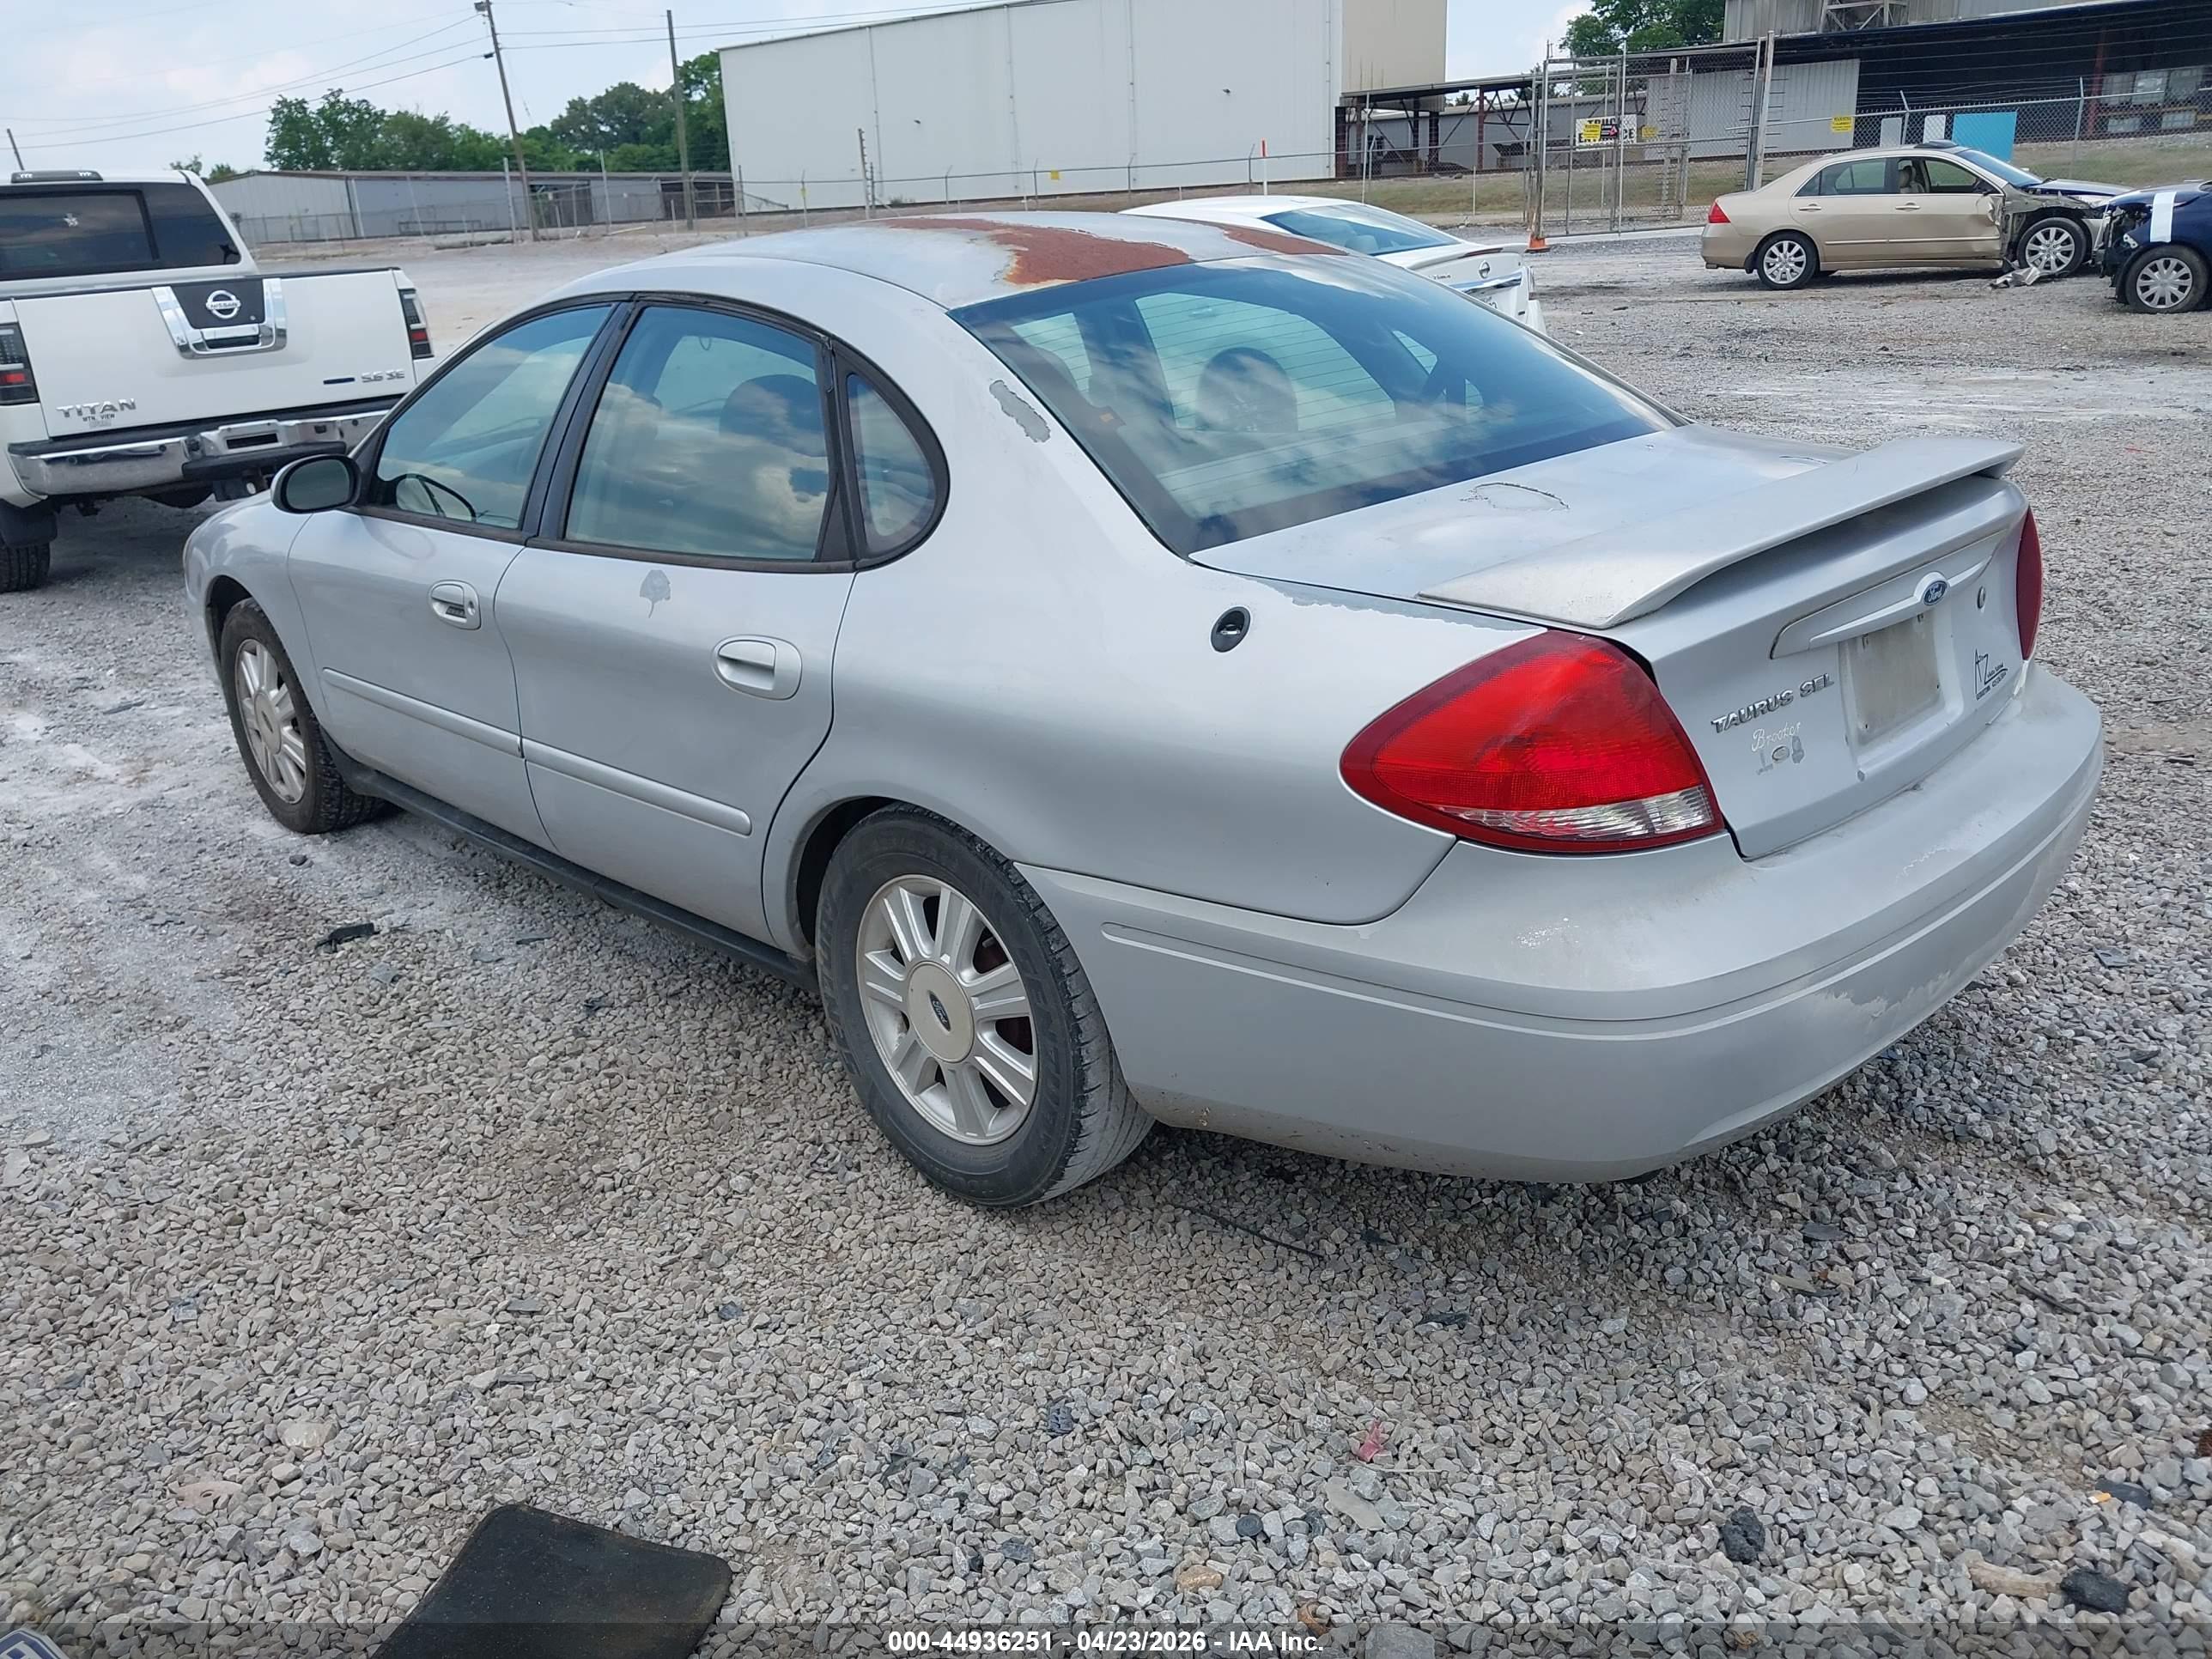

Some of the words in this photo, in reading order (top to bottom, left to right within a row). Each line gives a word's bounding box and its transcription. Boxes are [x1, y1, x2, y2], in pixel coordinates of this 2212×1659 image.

[386, 368, 405, 380] SE
[56, 398, 137, 418] TITAN
[1928, 584, 1944, 603] Ford
[1711, 690, 1795, 733] TAURUS
[1800, 672, 1835, 698] SEL
[932, 1000, 948, 1024] Ford
